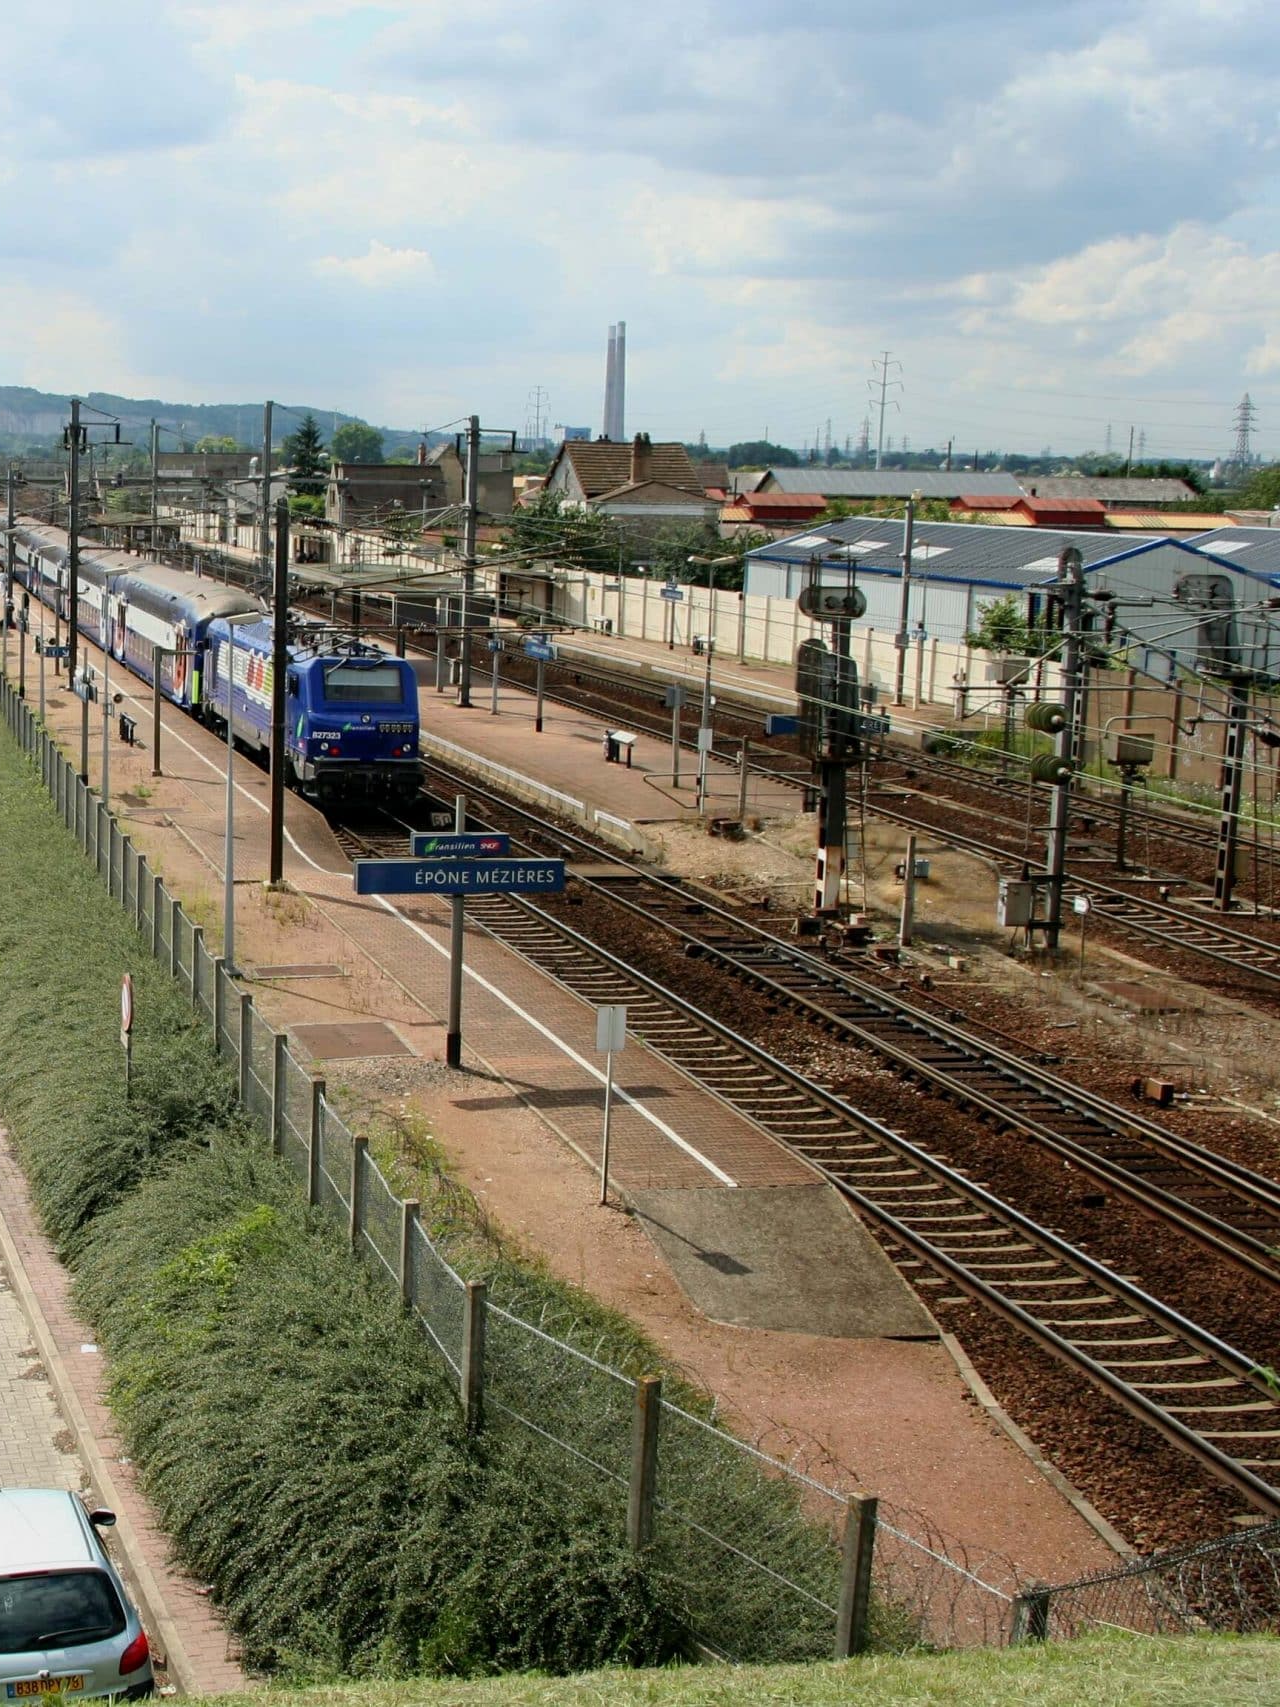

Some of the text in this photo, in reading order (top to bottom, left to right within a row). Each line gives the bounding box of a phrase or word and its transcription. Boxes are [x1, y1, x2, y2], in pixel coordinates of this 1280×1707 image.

[415, 867, 555, 885] ÉPÔNE MÉZIÈRES
[17, 1681, 40, 1695] 838
